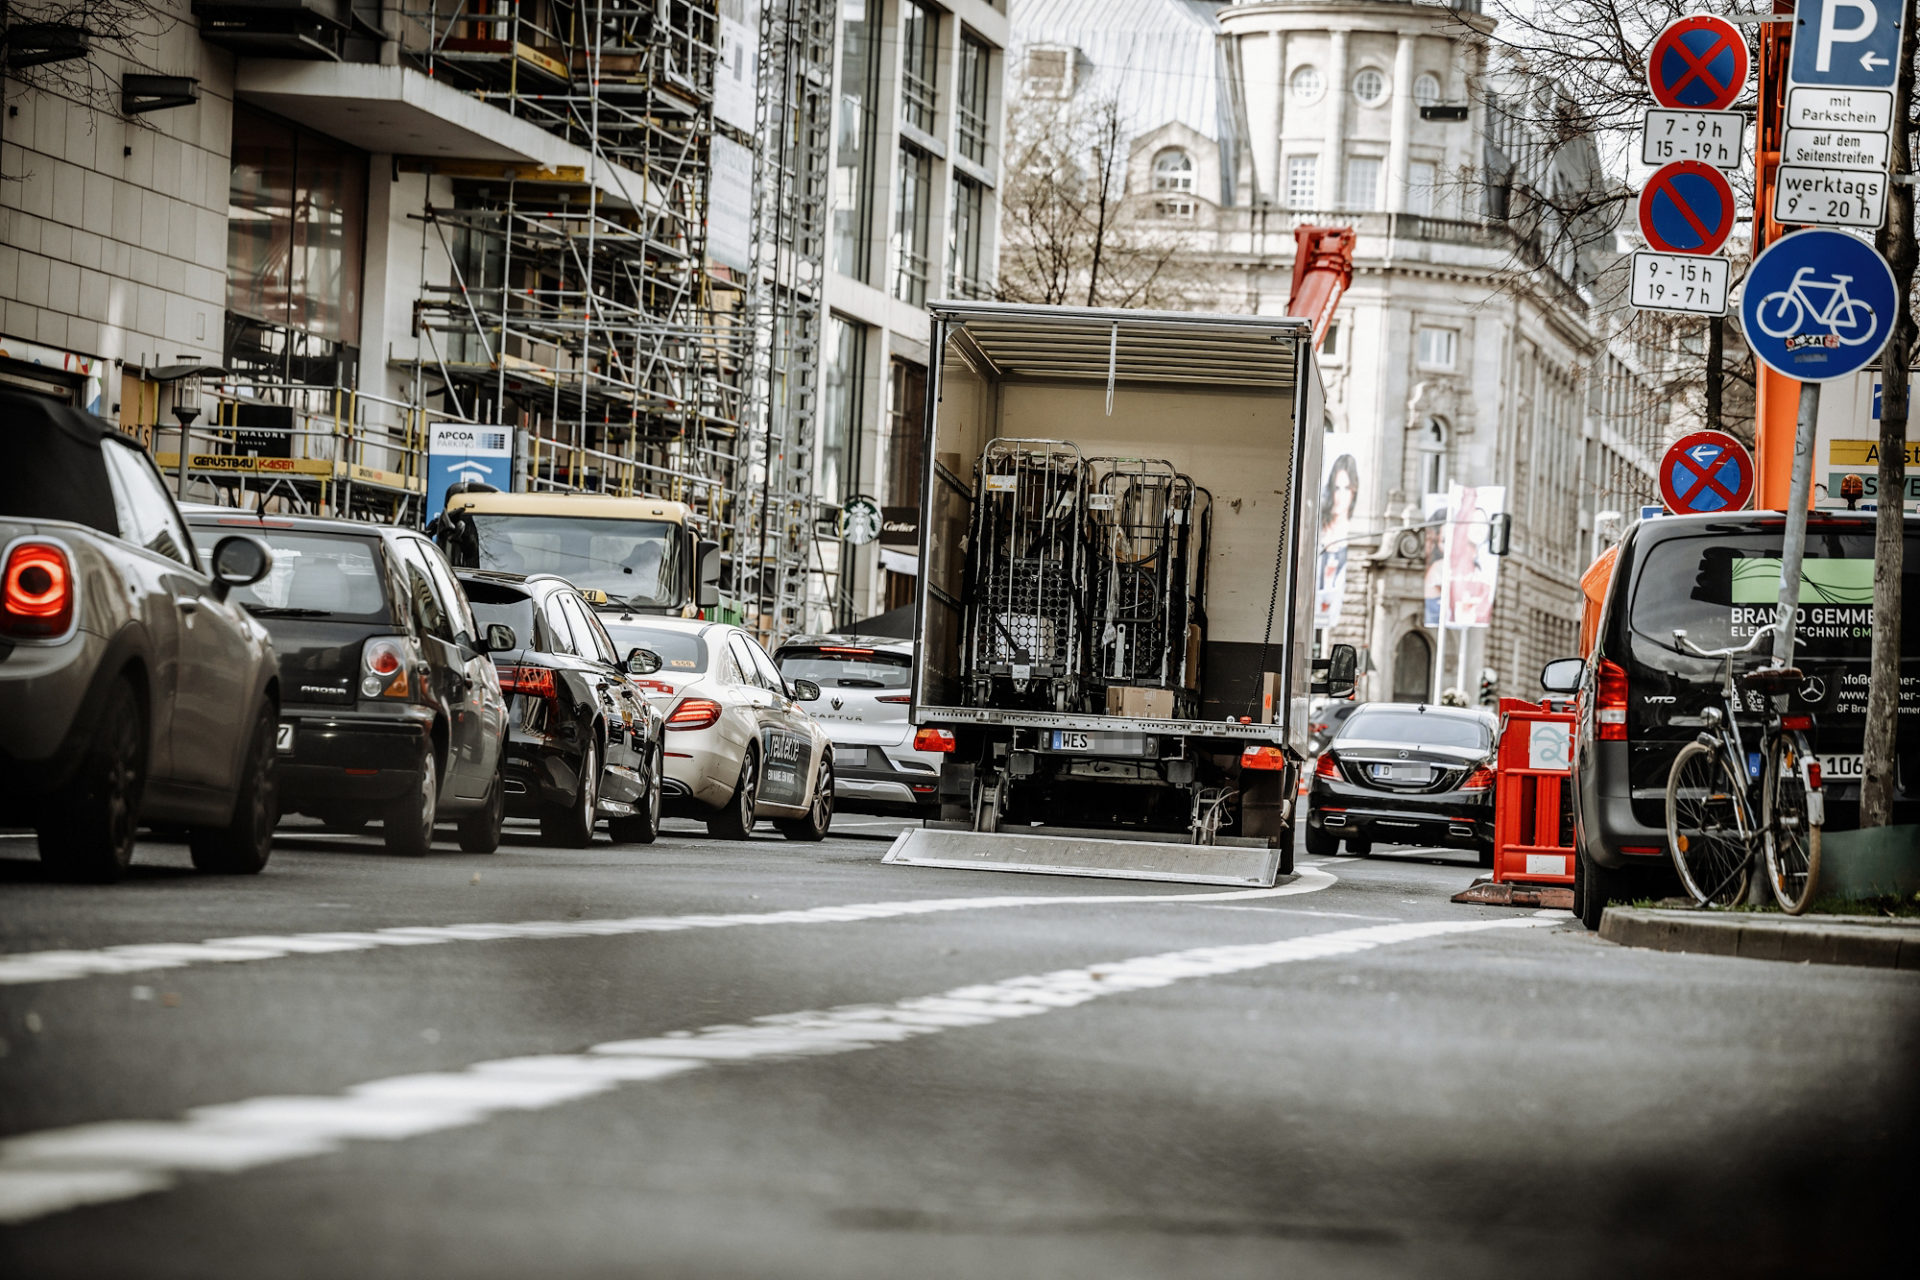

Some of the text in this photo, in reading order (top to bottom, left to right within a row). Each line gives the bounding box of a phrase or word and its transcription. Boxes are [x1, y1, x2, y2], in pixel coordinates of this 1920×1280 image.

[1816, 0, 1878, 72] P
[1830, 96, 1851, 107] mit
[1802, 108, 1876, 123] Parkschein
[1666, 119, 1675, 135] 7
[1697, 121, 1706, 137] 9
[1712, 121, 1722, 138] h
[1813, 134, 1860, 147] auf dem
[1657, 141, 1673, 157] 15
[1696, 143, 1712, 159] 19
[1718, 144, 1728, 160] h
[1797, 148, 1874, 164] Seitenstreifen
[1786, 176, 1878, 199] werktags
[1788, 197, 1798, 214] 9
[1827, 200, 1849, 218] 20
[1860, 199, 1870, 219] h
[1650, 262, 1658, 278] 9
[1680, 265, 1696, 281] 15
[1702, 266, 1711, 282] h
[1649, 284, 1664, 300] 19
[1686, 287, 1694, 302] 7
[1701, 288, 1709, 304] h
[438, 432, 474, 440] APCOA
[258, 460, 294, 469] KAISER
[883, 521, 917, 532] Cartier
[1731, 608, 1806, 624] BRANO
[1837, 703, 1849, 713] GF
[810, 712, 862, 721] CAPTUR
[1063, 733, 1087, 748] WES
